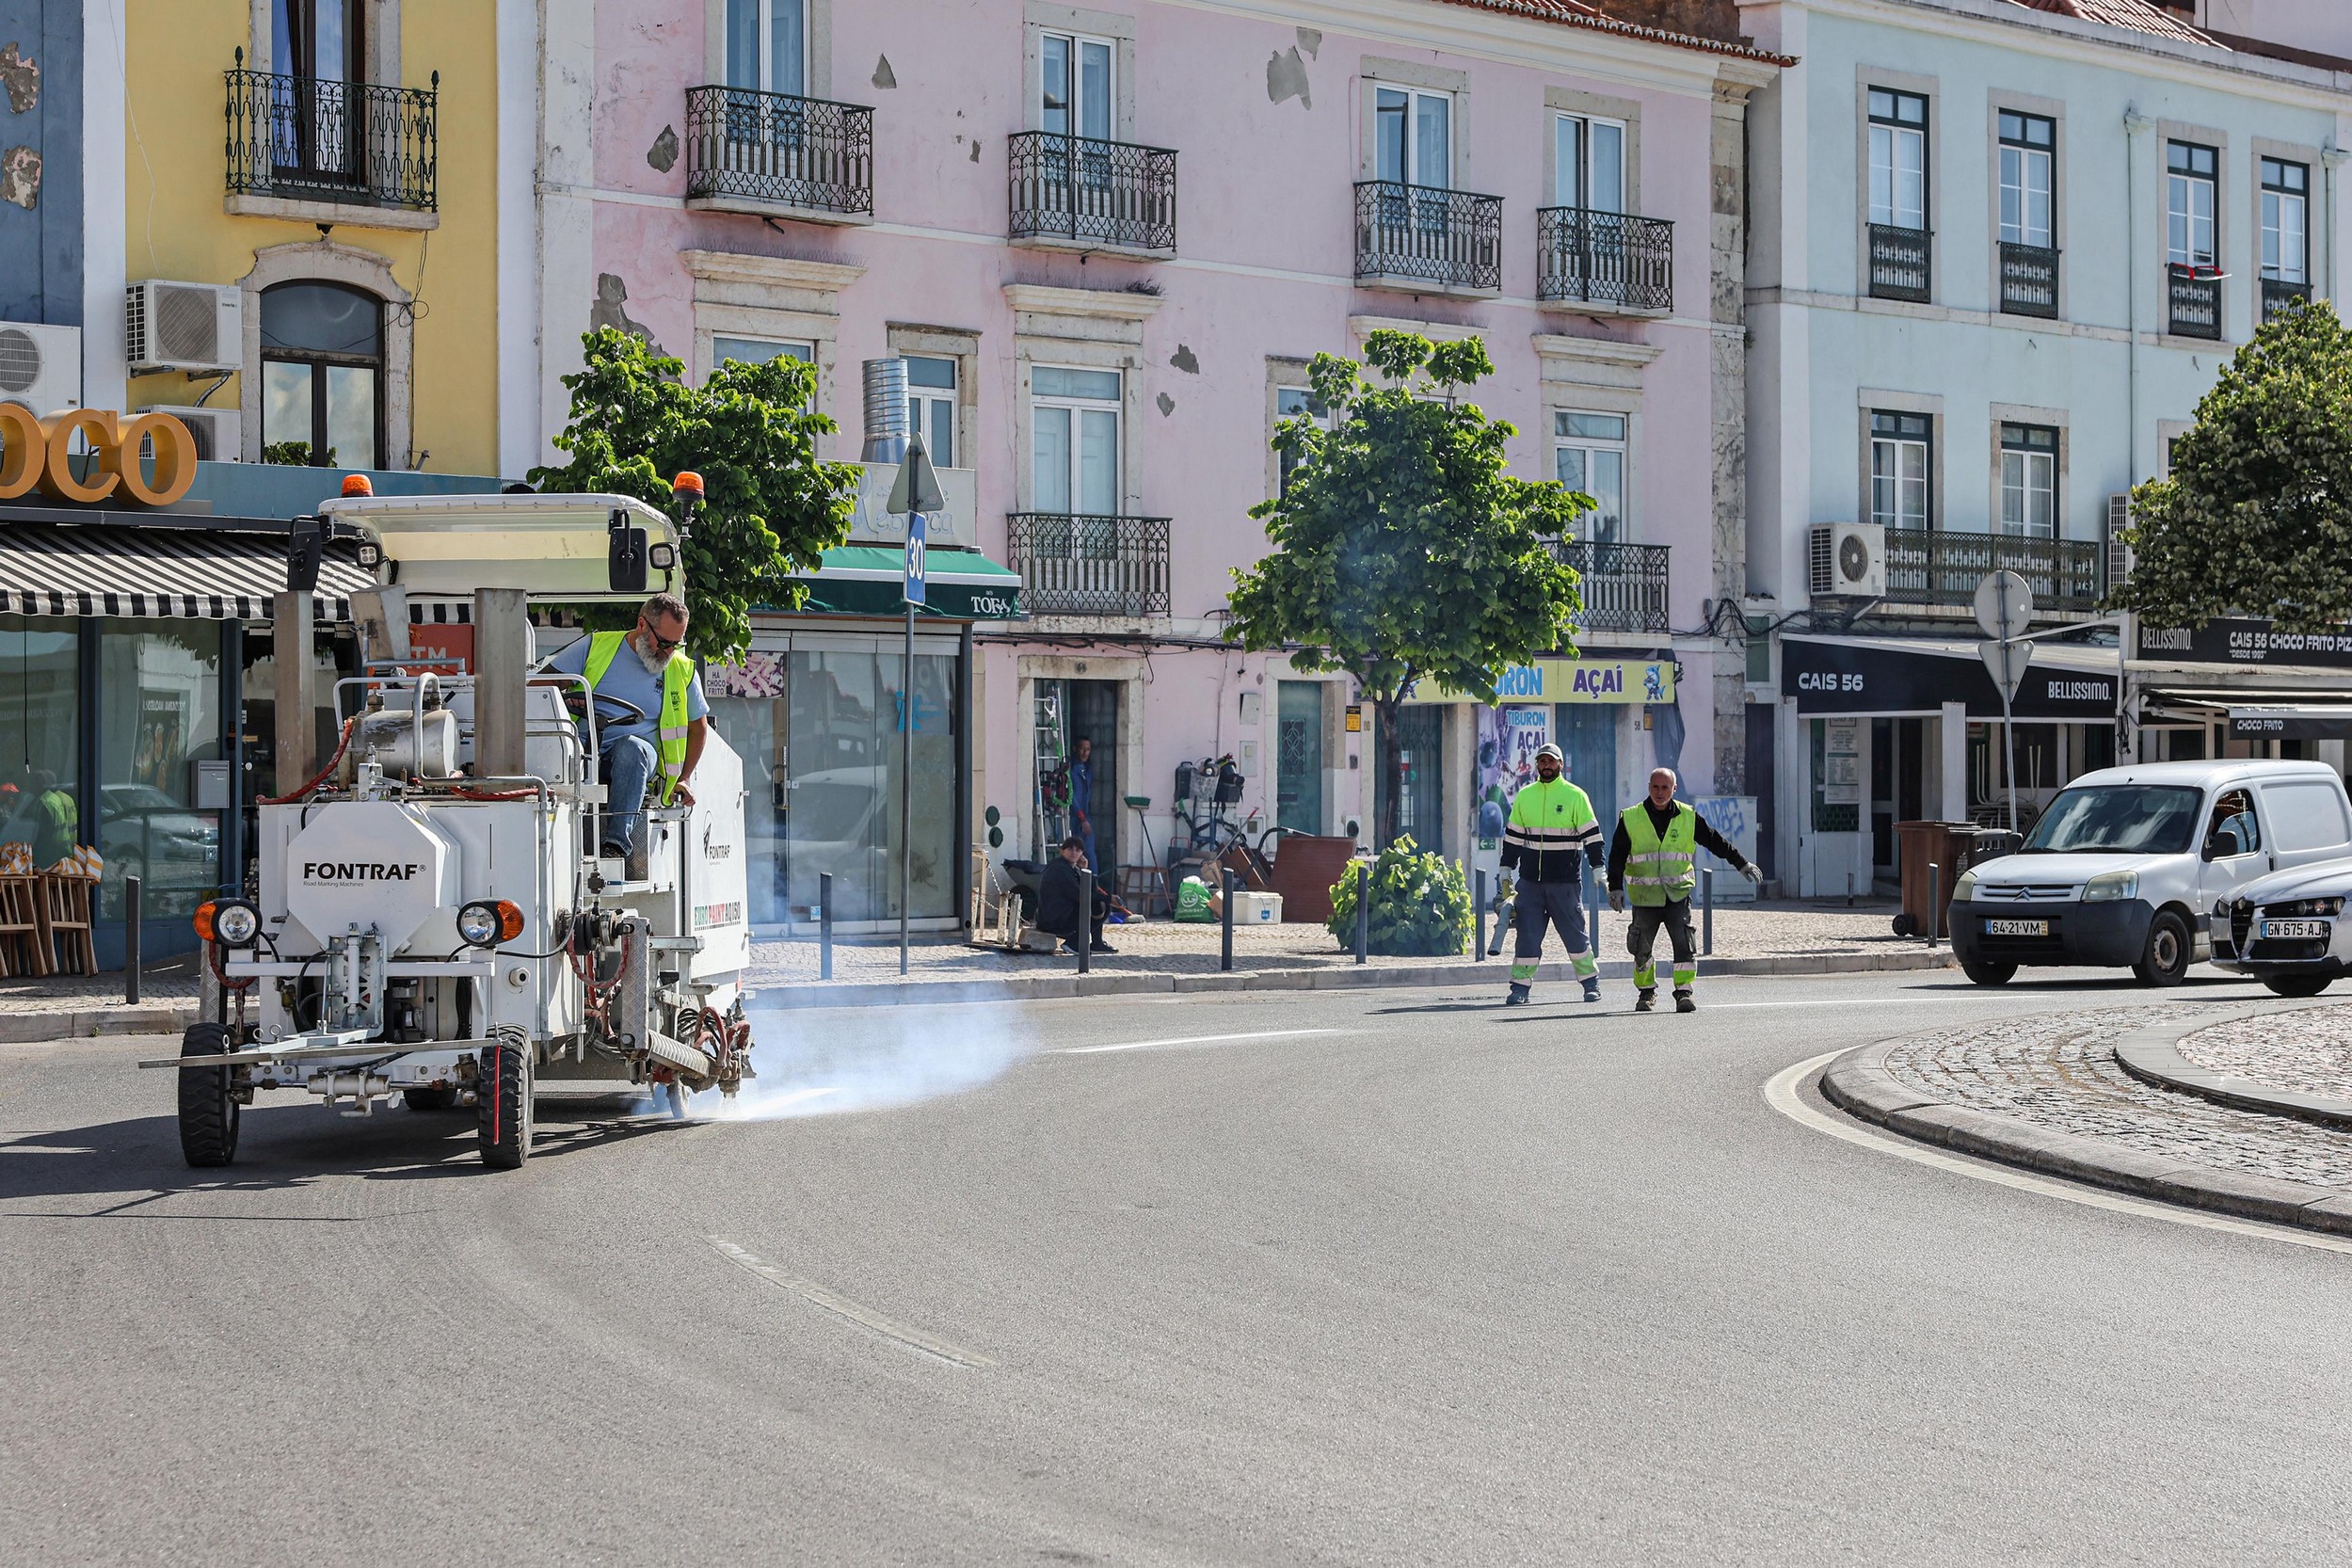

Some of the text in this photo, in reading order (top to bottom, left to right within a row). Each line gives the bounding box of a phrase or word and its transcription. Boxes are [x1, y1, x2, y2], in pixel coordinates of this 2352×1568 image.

[908, 536, 923, 581] 30
[2230, 632, 2252, 648] CAIS
[2254, 632, 2267, 648] 56
[2269, 633, 2304, 650] CHOCO
[2306, 634, 2334, 651] FRITO
[1798, 672, 1864, 692] CAIS 56
[1507, 711, 1545, 727] TIBURON
[2237, 719, 2283, 730] CHOCO FRITO
